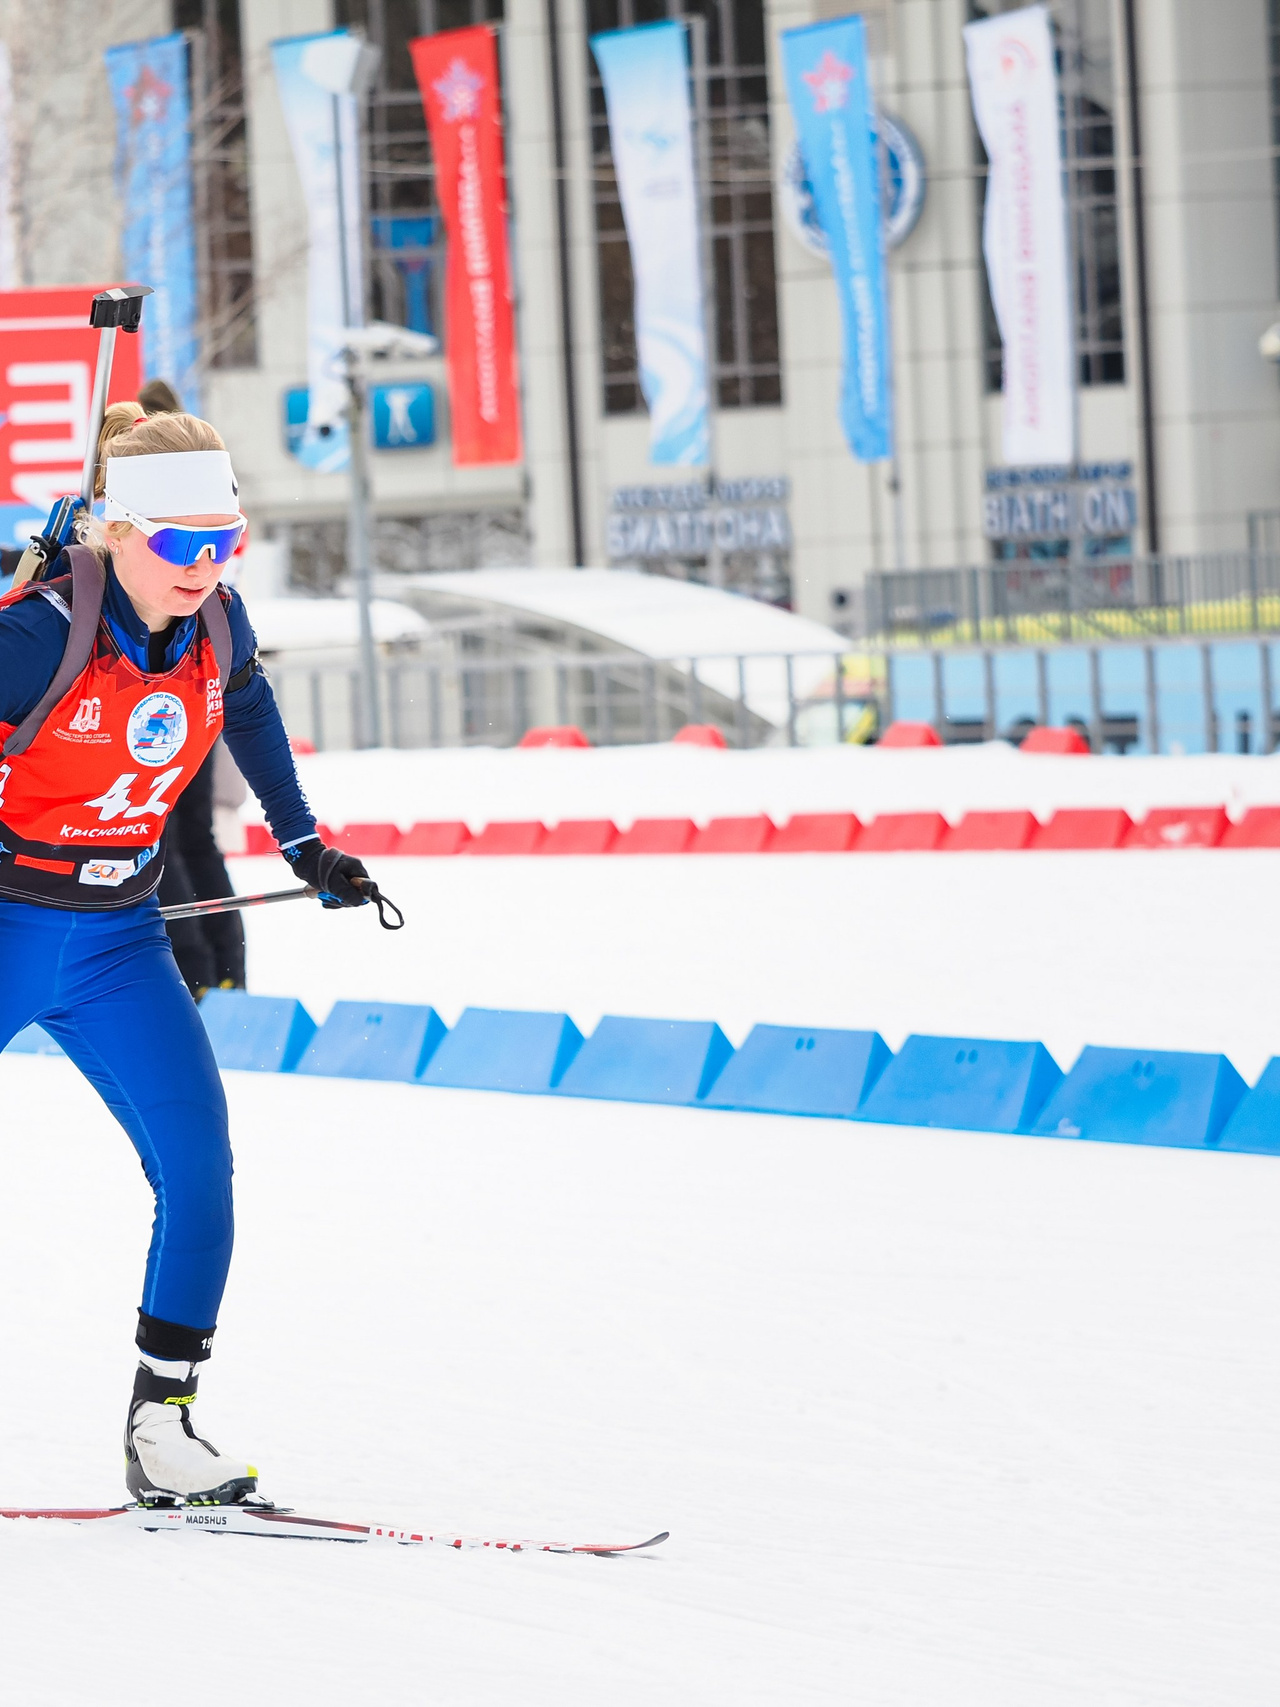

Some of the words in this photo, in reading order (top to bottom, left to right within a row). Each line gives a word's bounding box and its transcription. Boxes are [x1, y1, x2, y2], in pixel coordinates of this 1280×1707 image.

[132, 694, 164, 718] ПЕРВЕНСТВО
[82, 766, 184, 821] 41
[185, 1515, 227, 1526] MADSHUS
